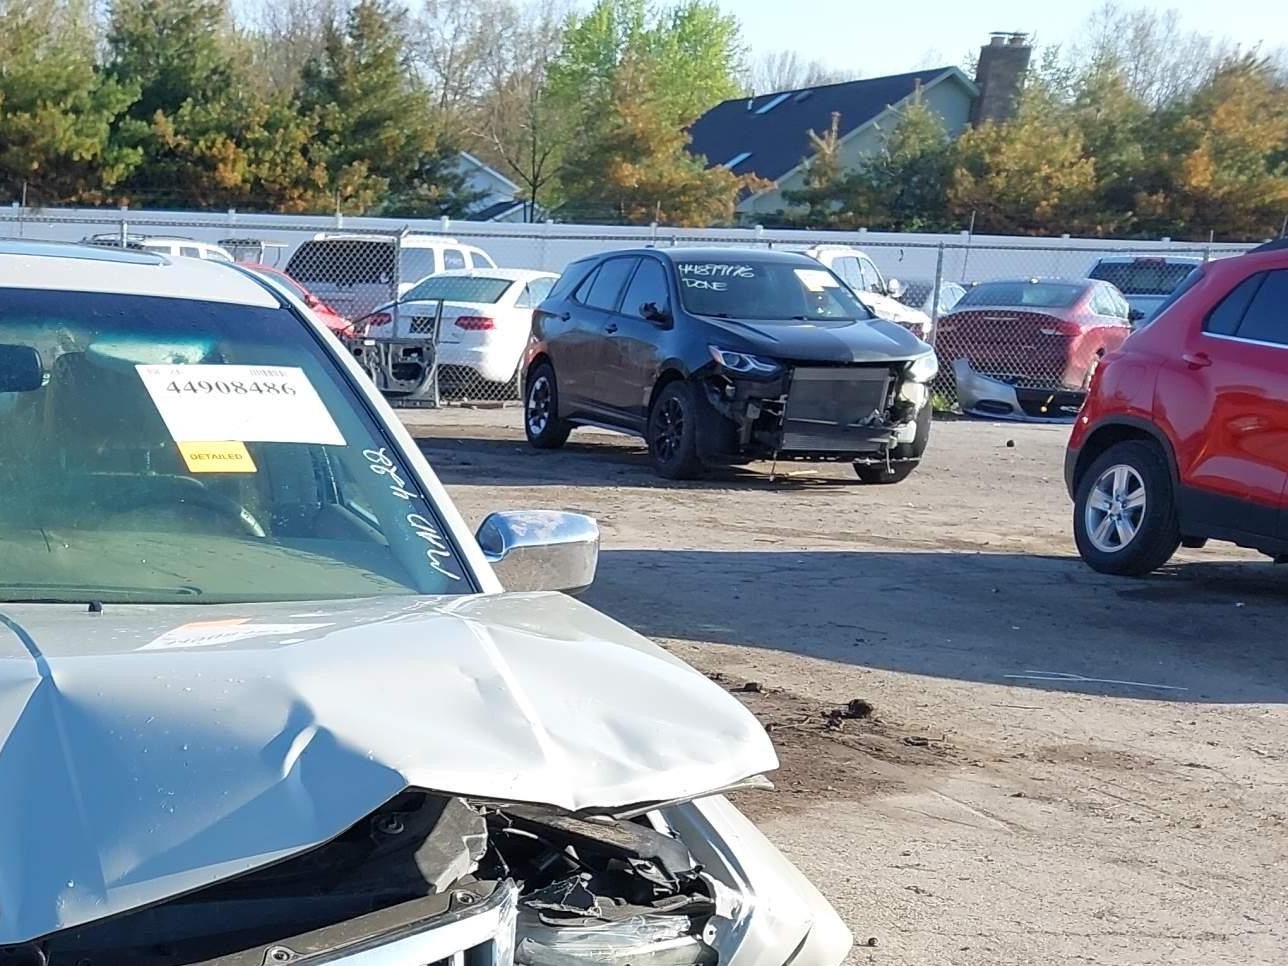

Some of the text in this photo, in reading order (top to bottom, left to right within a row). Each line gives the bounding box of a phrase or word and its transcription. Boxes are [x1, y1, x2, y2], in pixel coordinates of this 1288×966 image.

[682, 278, 729, 292] DONE
[166, 380, 297, 396] 44908486
[190, 453, 243, 461] DETAILED
